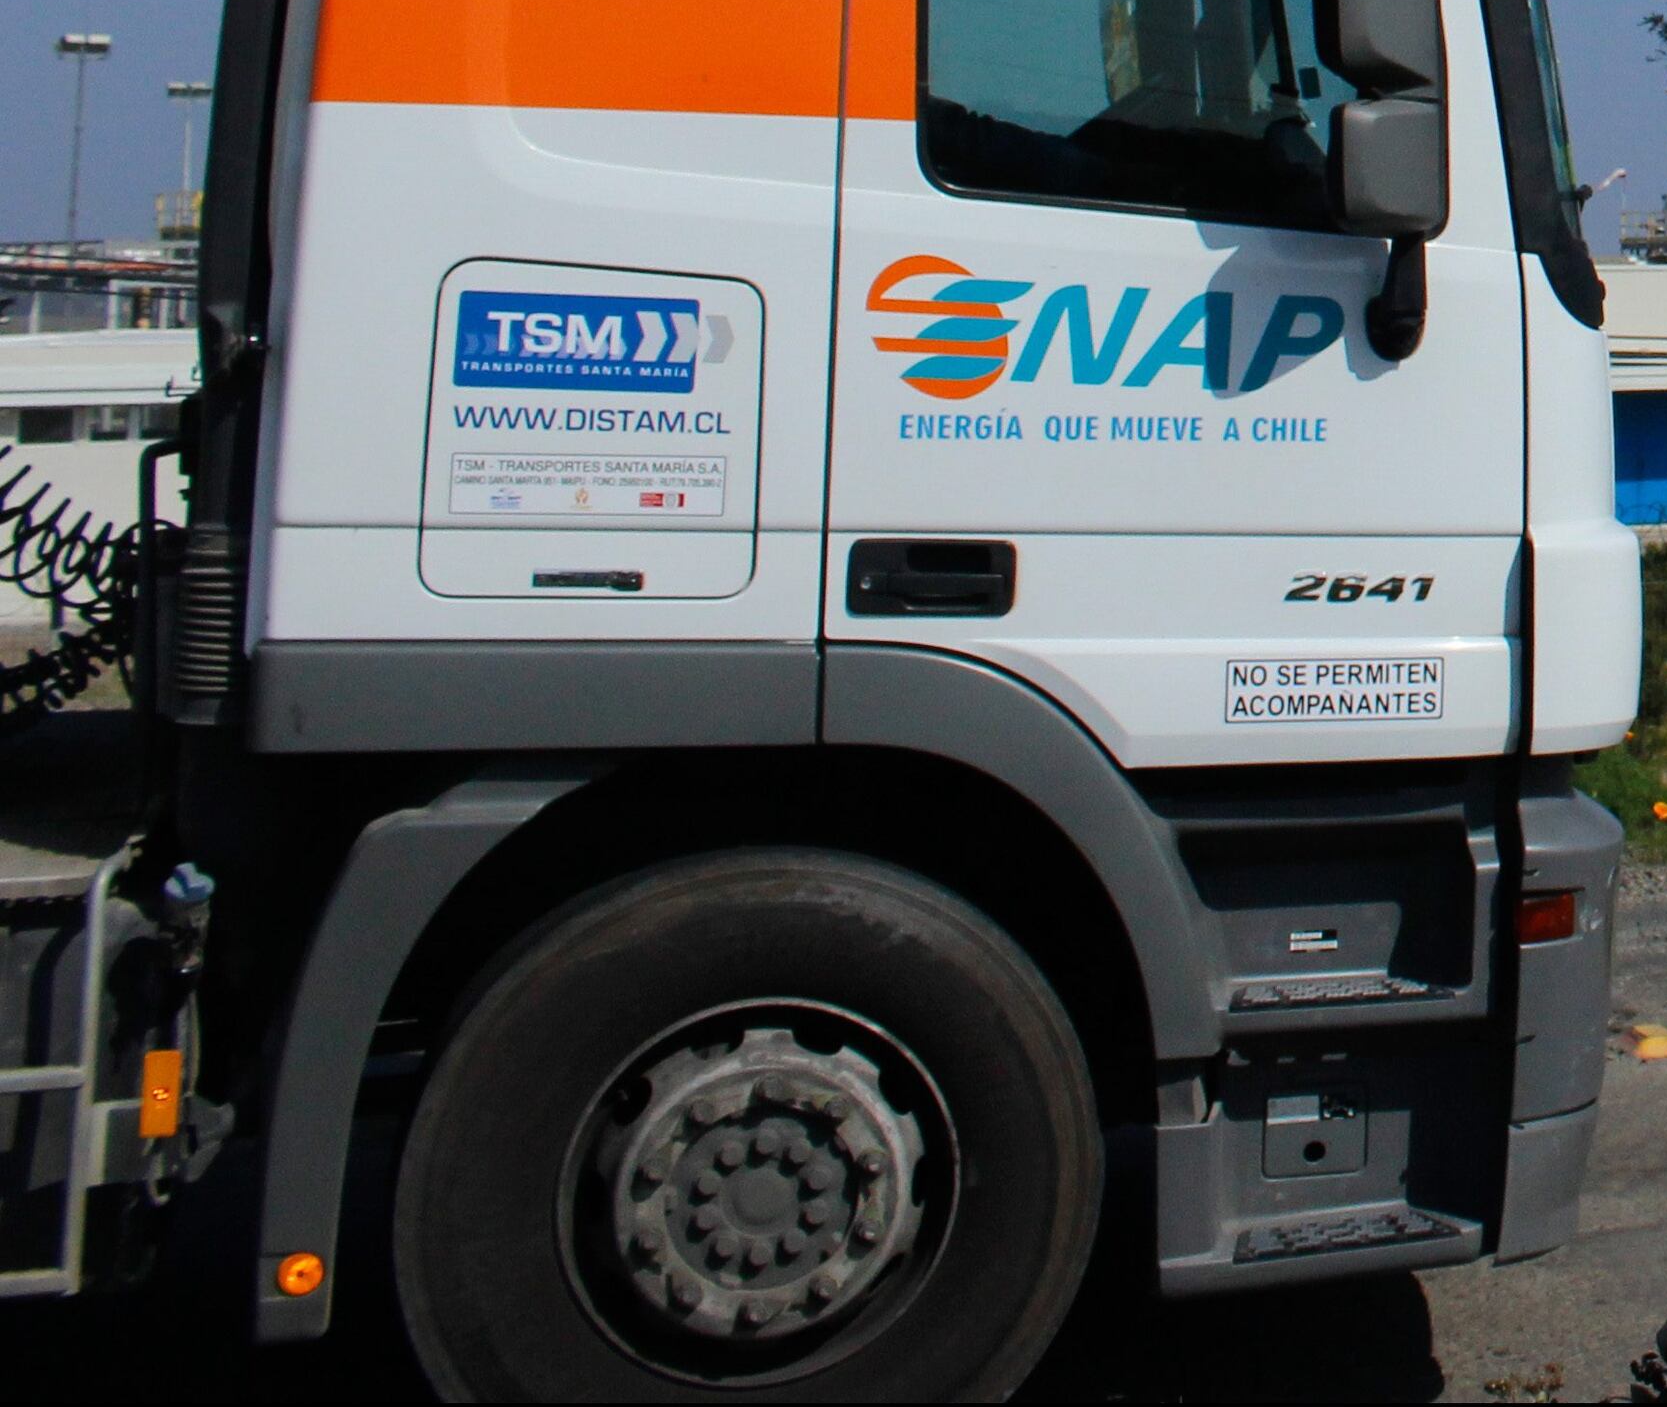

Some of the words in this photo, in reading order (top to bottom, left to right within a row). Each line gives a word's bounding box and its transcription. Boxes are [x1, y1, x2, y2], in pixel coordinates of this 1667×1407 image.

[486, 310, 623, 355] TSM
[461, 360, 574, 375] TRANSPORTES
[580, 364, 632, 377] SANTA
[639, 366, 689, 379] MARÍA
[453, 405, 731, 434] WWW.DISTAM.CL
[899, 408, 1023, 440] ENERGÍA
[1044, 415, 1098, 442] QUE
[1110, 416, 1203, 442] MUEVE
[1223, 417, 1241, 442] A
[1251, 417, 1328, 443] CHILE
[456, 459, 486, 472] TSM
[498, 460, 600, 473] TRANSPORTES
[604, 461, 649, 473] SANTA
[1283, 573, 1436, 603] 2641
[1232, 665, 1268, 686] NO
[1277, 664, 1307, 686] SE
[1315, 662, 1438, 686] PERMITEN
